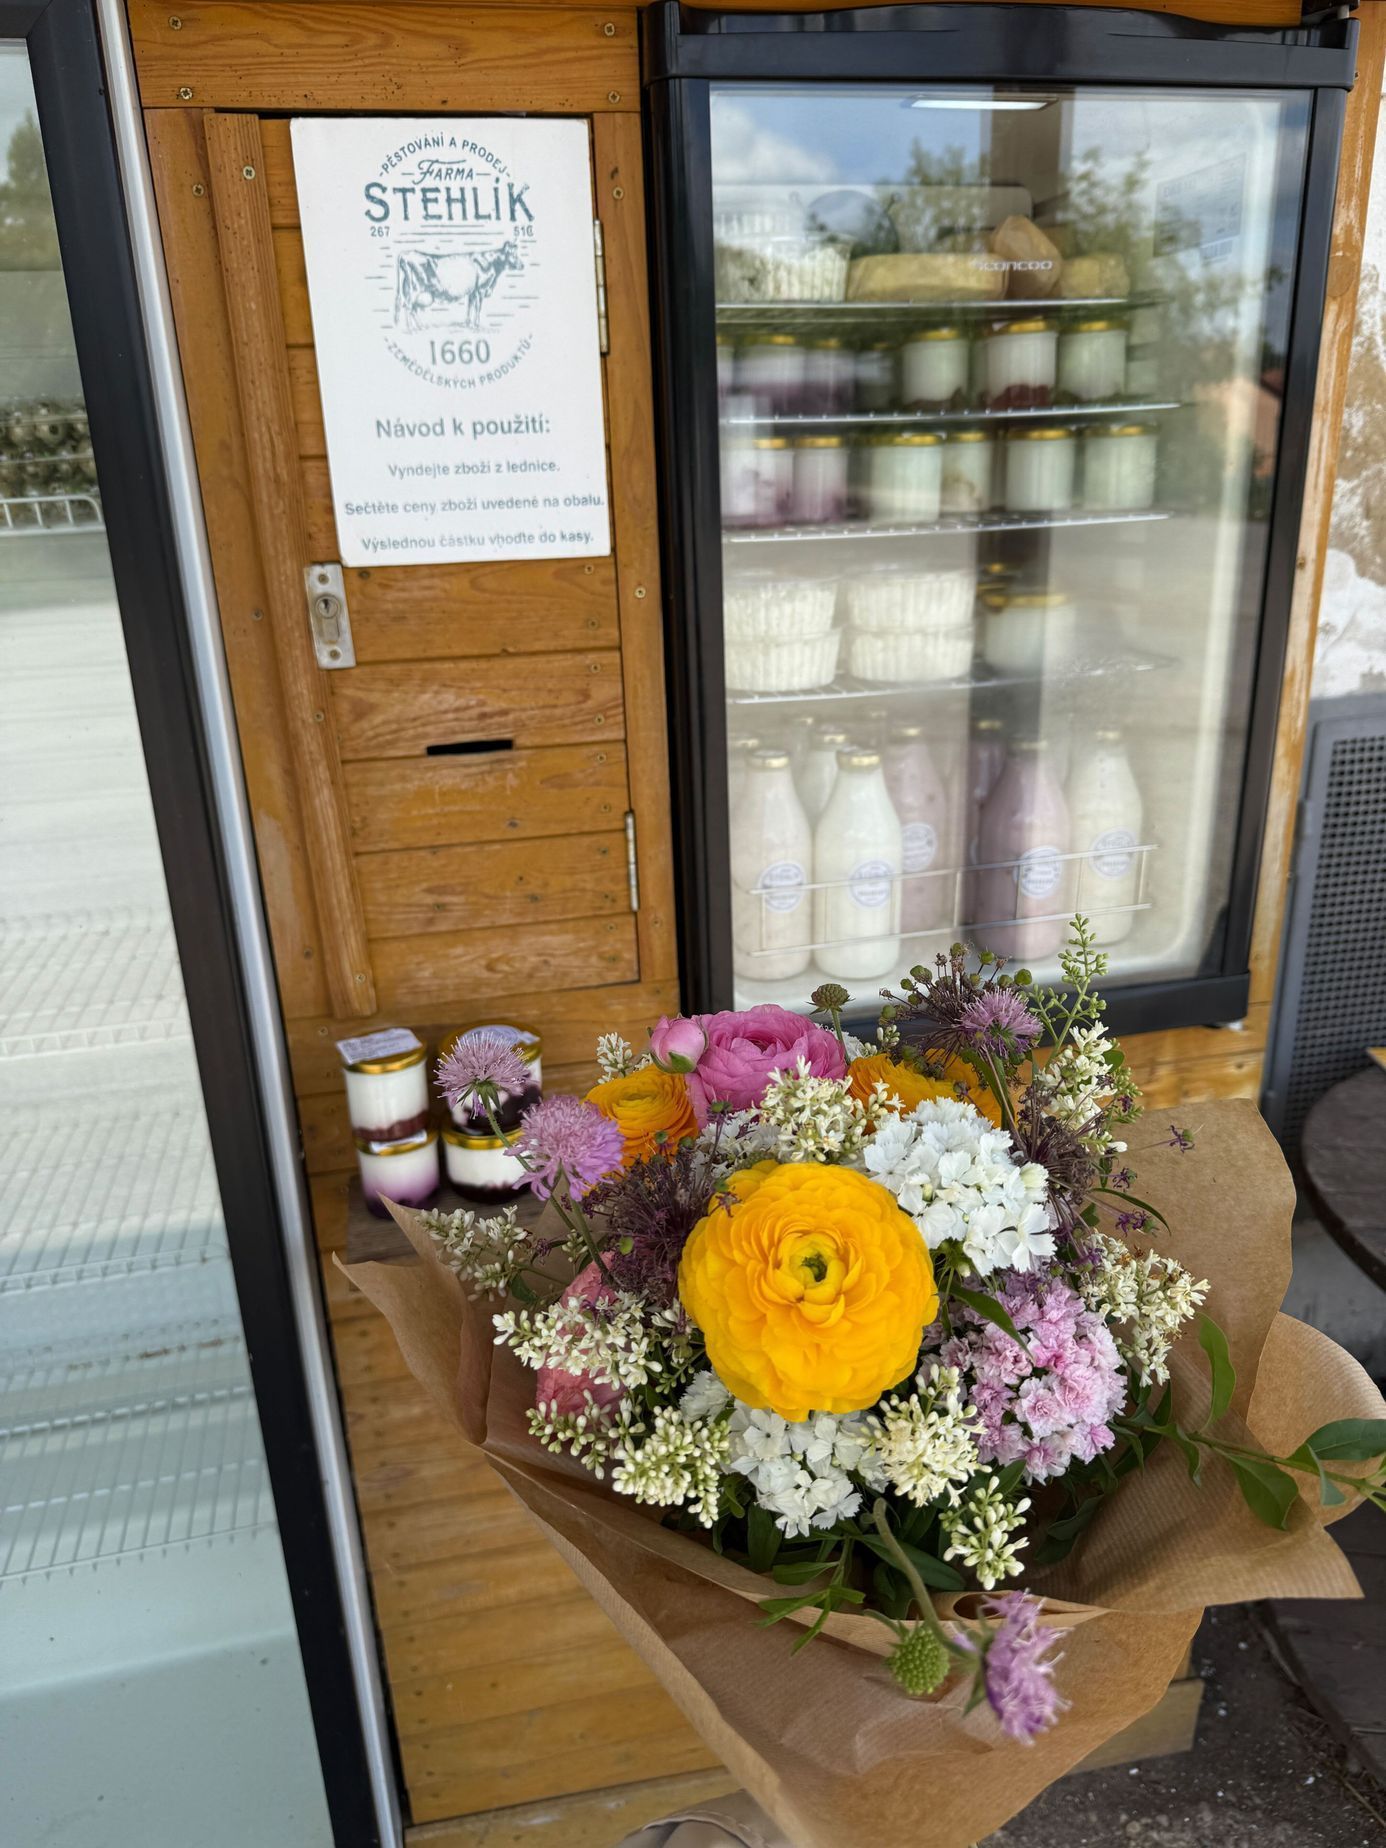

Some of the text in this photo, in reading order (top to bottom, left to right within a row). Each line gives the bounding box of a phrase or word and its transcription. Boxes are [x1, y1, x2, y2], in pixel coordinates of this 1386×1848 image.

[449, 136, 457, 148] A
[462, 139, 508, 174] PRODEJ
[364, 176, 535, 223] STEHLÍK
[370, 225, 390, 238] 267
[430, 338, 490, 366] 1660
[375, 413, 551, 440] Návod k použití:
[388, 463, 450, 480] Vyndejte
[495, 463, 503, 473] z
[506, 459, 561, 473] lednice.
[403, 502, 436, 515] ceny
[543, 496, 560, 508] na
[563, 492, 605, 508] obalu.
[361, 535, 436, 553] Výslednou
[538, 531, 556, 543] do
[560, 529, 595, 545] kasy.
